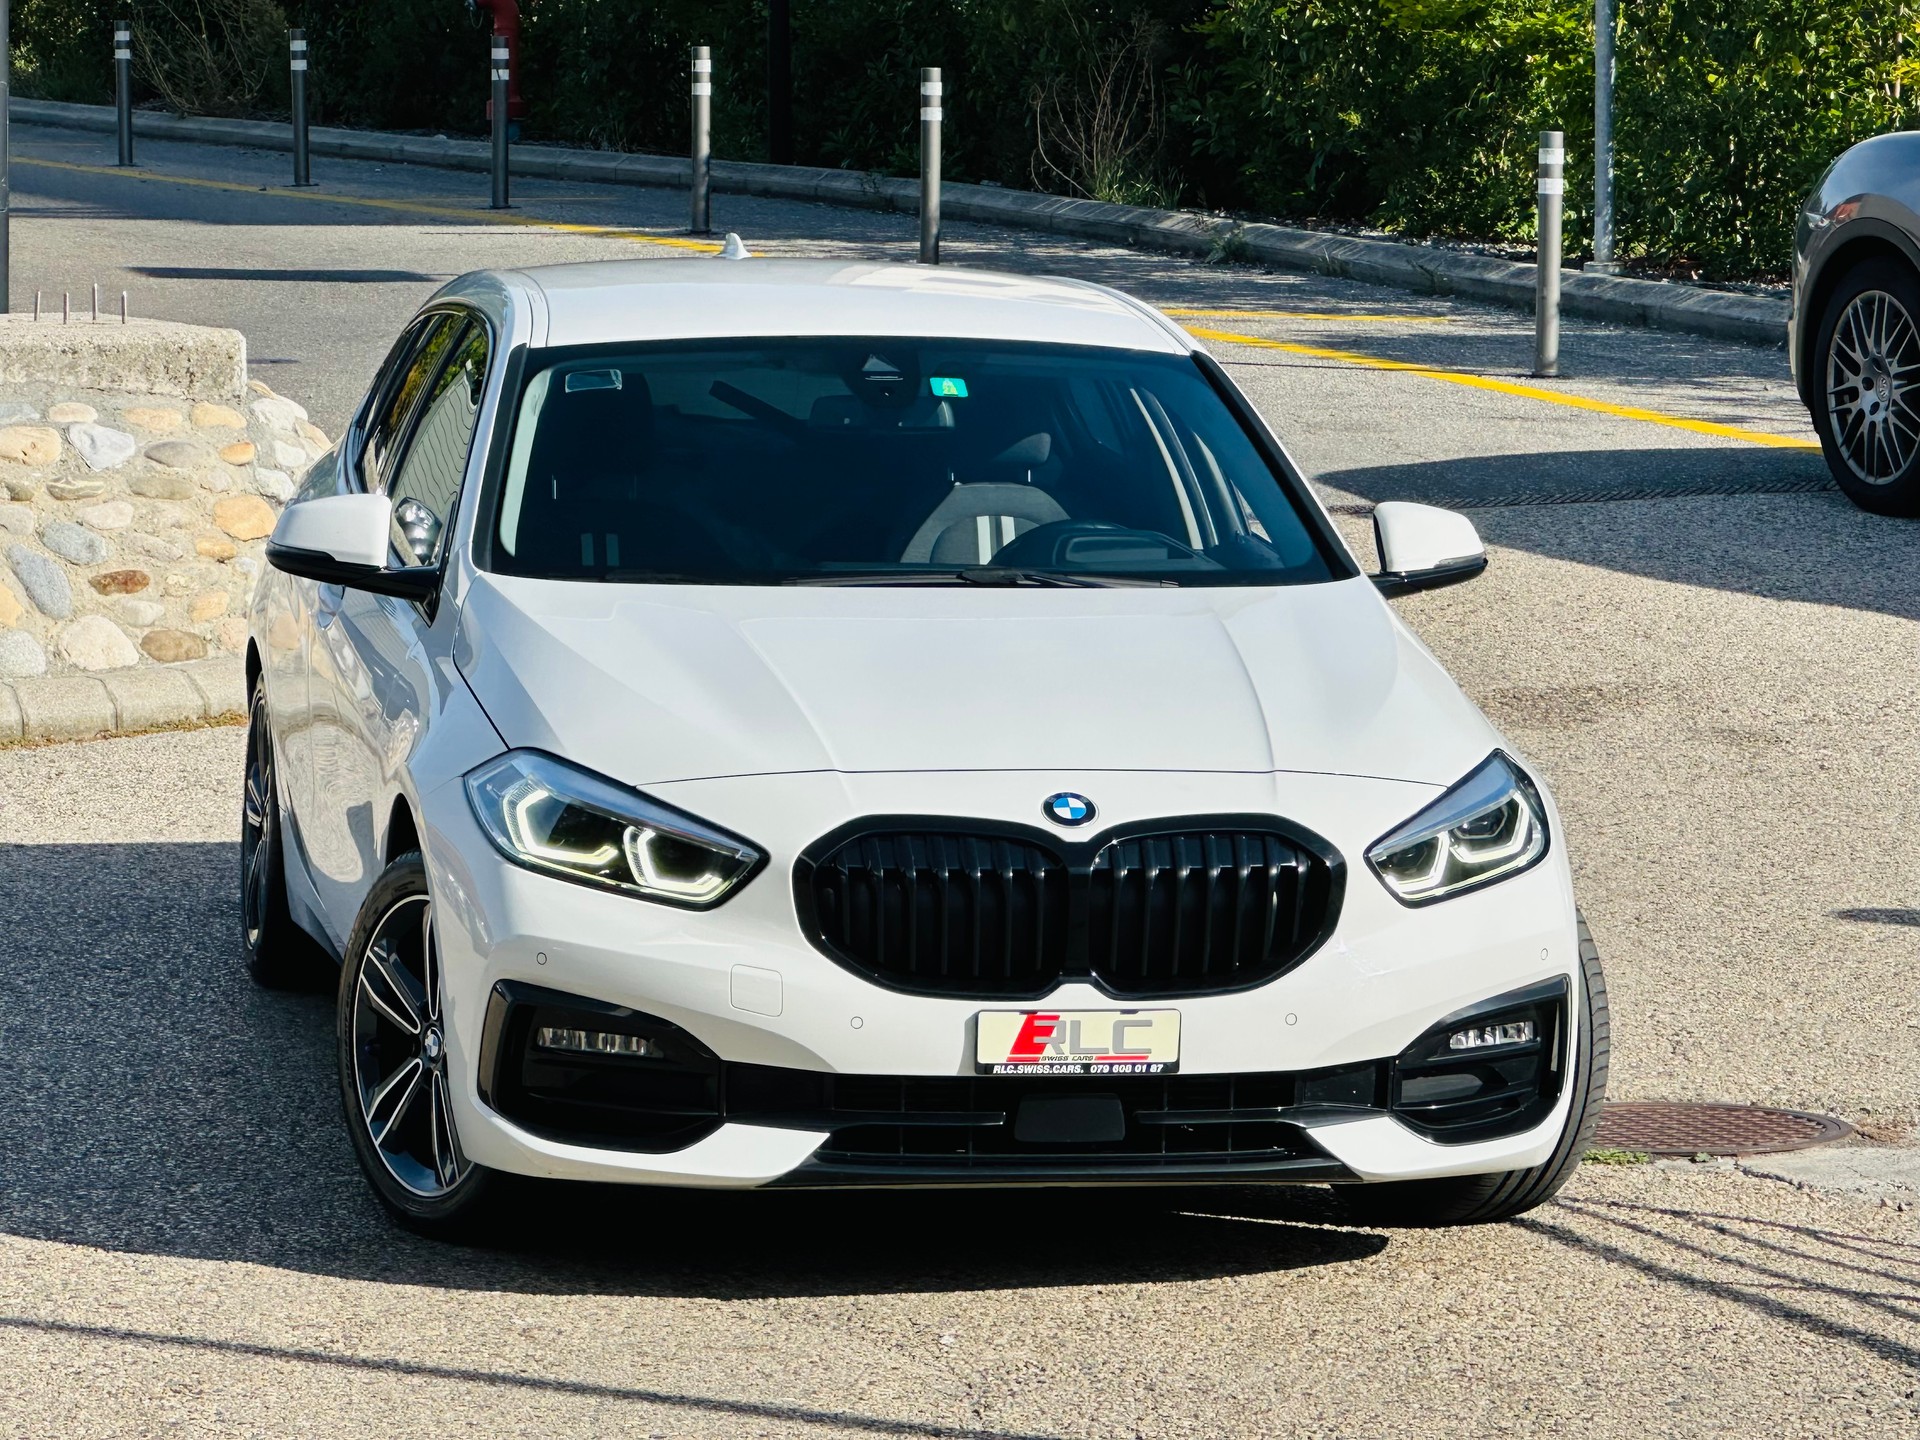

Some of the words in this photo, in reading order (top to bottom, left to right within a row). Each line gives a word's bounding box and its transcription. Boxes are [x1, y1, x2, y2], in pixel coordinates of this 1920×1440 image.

[1090, 1064, 1110, 1073] 079
[1134, 1064, 1147, 1073] 01
[1149, 1063, 1164, 1073] 87
